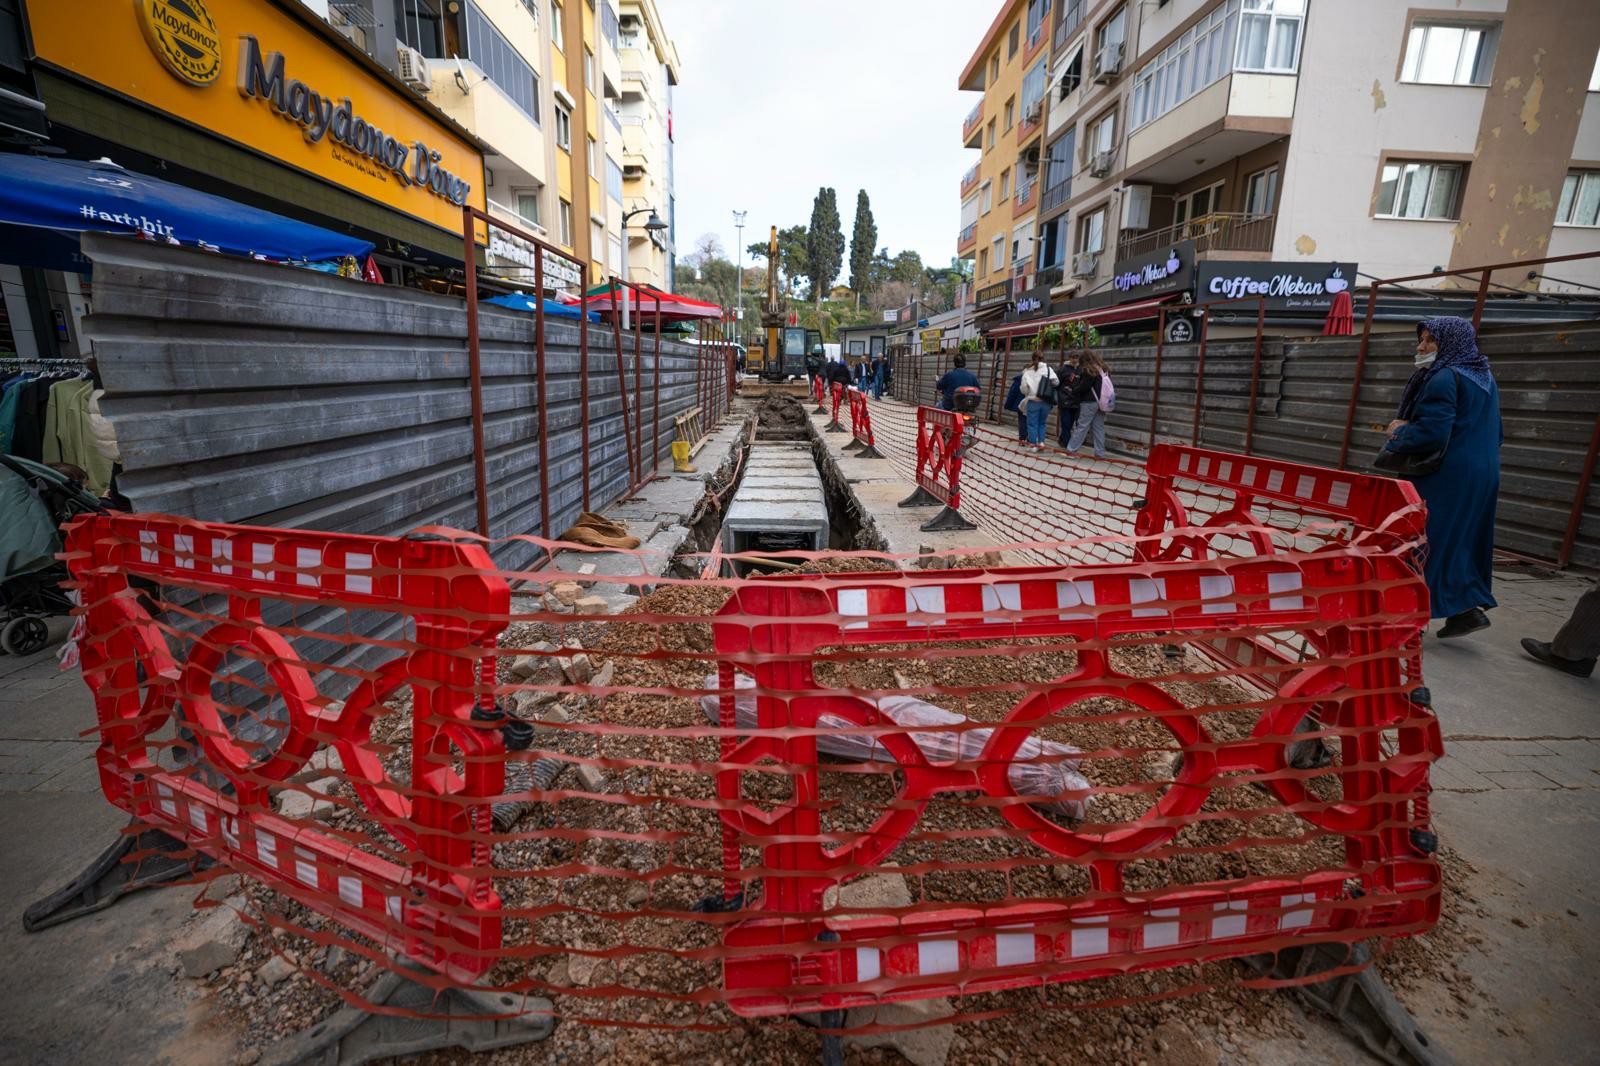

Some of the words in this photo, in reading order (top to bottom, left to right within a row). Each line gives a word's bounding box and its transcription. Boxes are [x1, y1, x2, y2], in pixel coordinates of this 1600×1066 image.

[152, 1, 220, 56] Maydonoz
[238, 34, 412, 187] Maydonoz
[409, 140, 470, 205] Döner
[1114, 272, 1141, 291] Coffee
[1209, 276, 1269, 299] Coffee
[1269, 274, 1324, 297] Mekan
